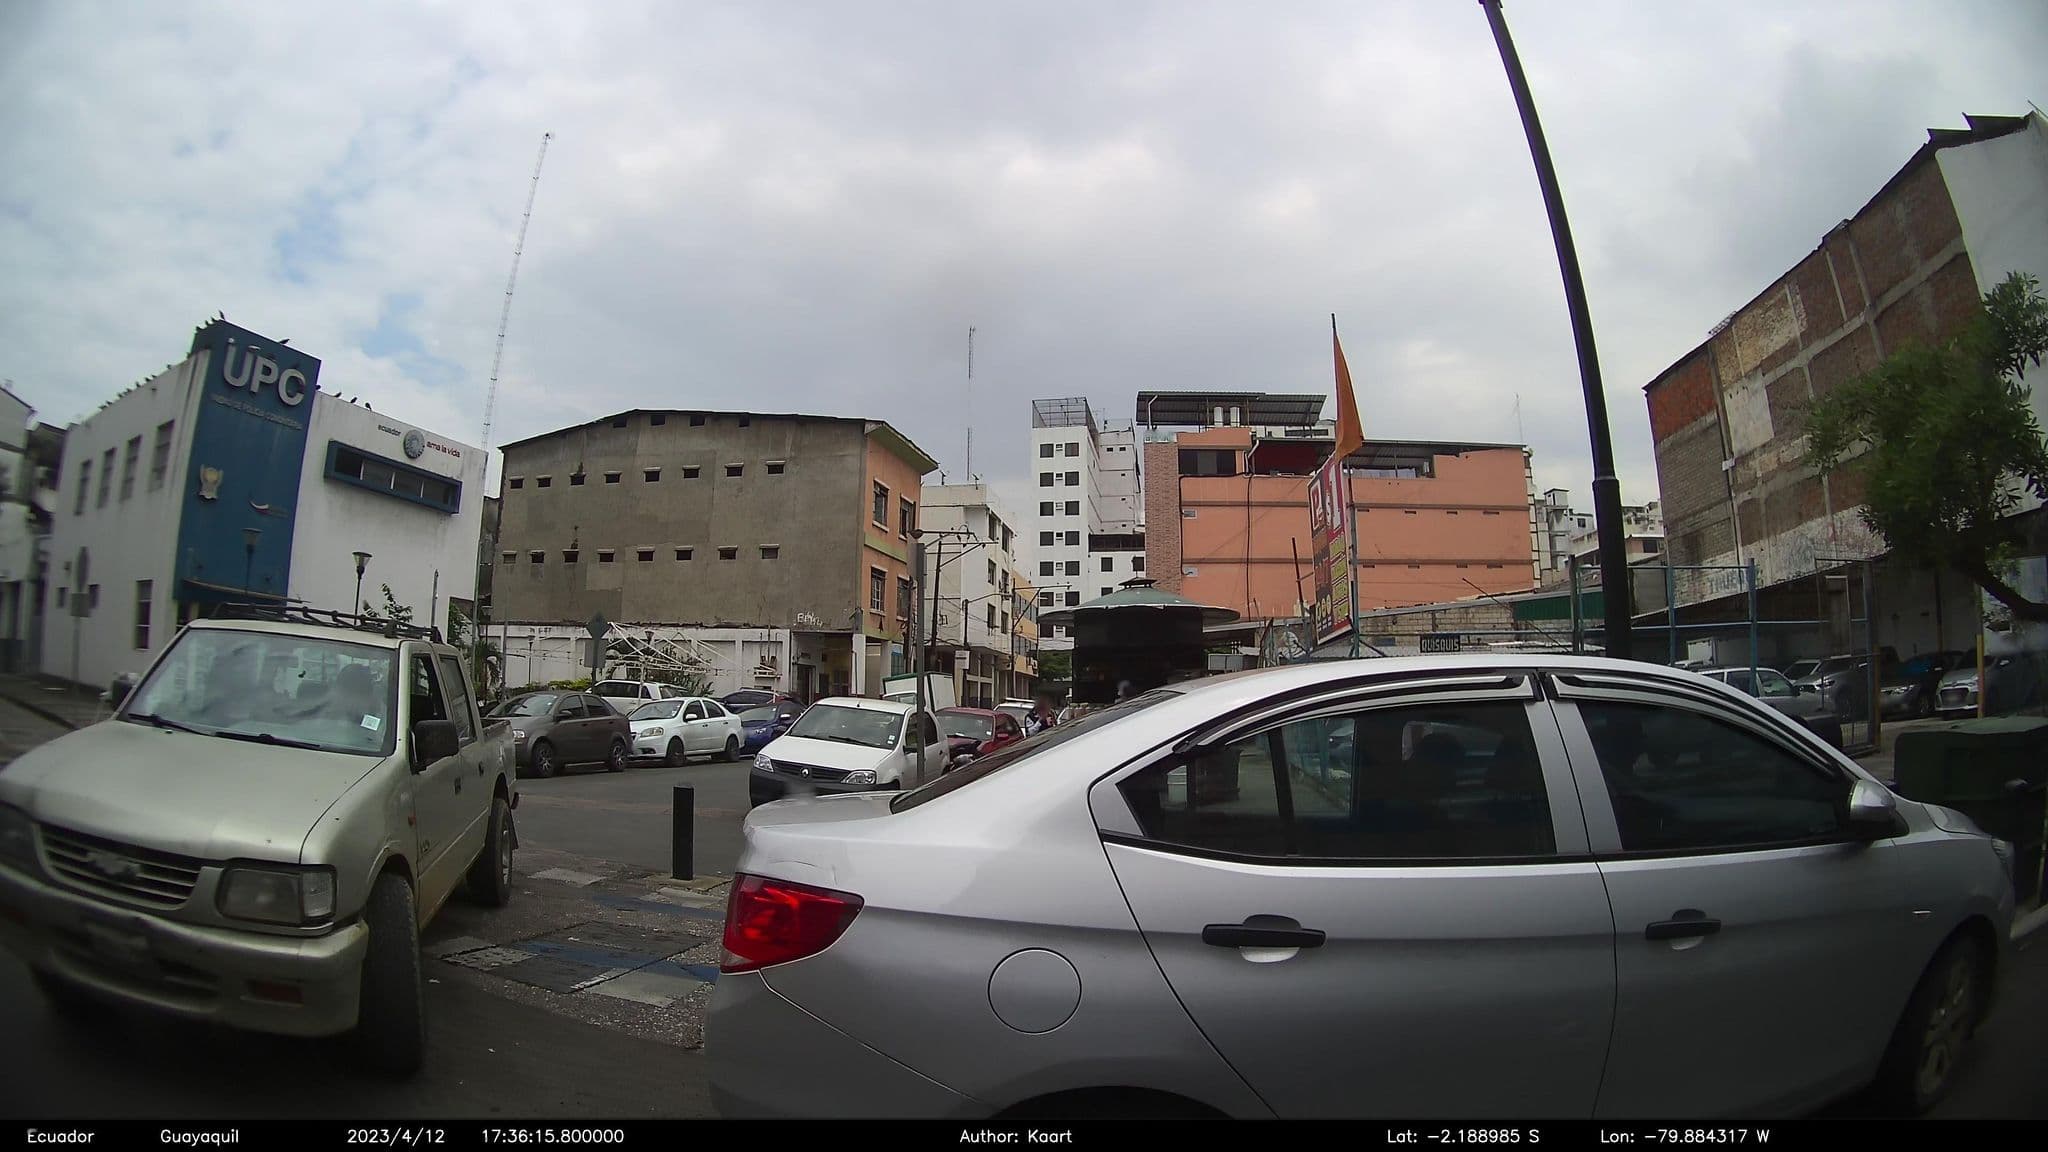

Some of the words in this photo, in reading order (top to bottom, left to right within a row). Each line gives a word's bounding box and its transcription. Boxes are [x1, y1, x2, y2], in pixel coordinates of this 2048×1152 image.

[223, 338, 305, 406] UPC
[378, 424, 401, 436] ecuador
[426, 441, 441, 451] ama
[441, 444, 447, 453] la
[447, 447, 461, 458] vida
[1421, 639, 1460, 652] QUISQUIS
